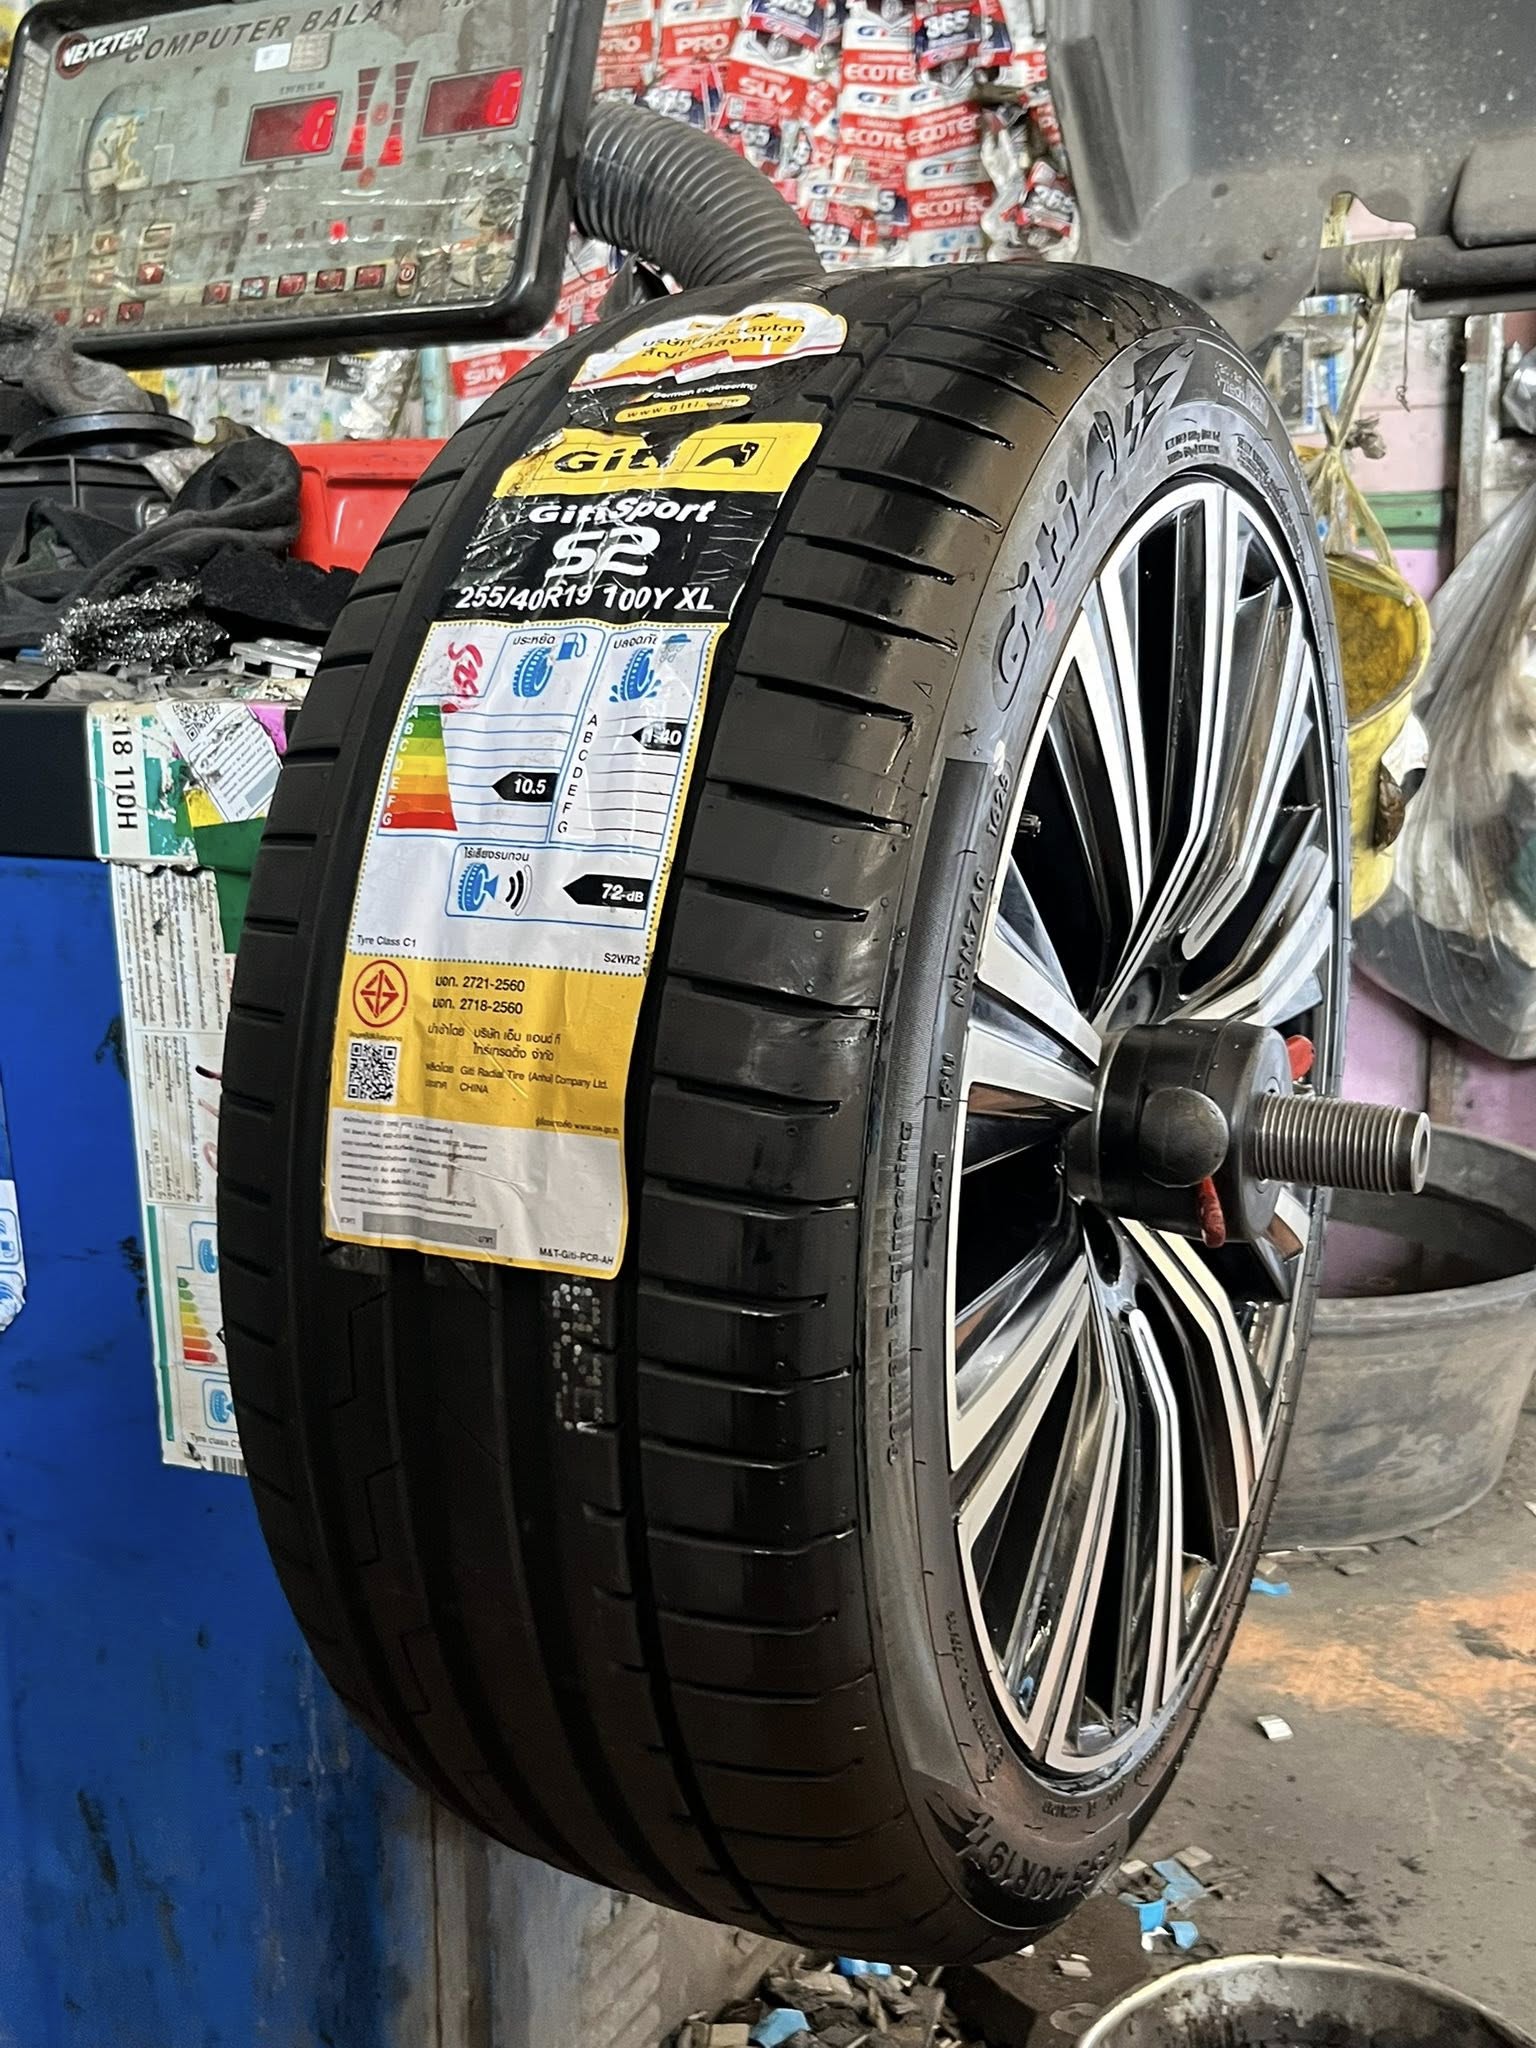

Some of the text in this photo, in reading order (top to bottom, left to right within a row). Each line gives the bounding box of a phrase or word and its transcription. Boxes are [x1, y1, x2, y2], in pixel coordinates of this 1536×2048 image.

[63, 25, 149, 67] NEXZTER
[125, 16, 292, 63] COMPUTER
[675, 33, 731, 54] PRO
[738, 76, 793, 103] SUV
[463, 365, 507, 385] SUV
[653, 382, 758, 400] German Engineering
[529, 497, 717, 524] GitiSport
[546, 526, 661, 577] S2
[455, 584, 715, 611] 255/40R19 100Y XL
[408, 706, 419, 719] A
[587, 714, 598, 726] A
[404, 722, 414, 735] B
[583, 732, 593, 743] B
[399, 740, 409, 752] C
[578, 749, 588, 761] C
[573, 766, 583, 778] D
[390, 777, 400, 789] E
[514, 779, 547, 795] 10.5
[568, 784, 578, 796] E
[114, 765, 138, 829] 110H
[386, 795, 396, 808] F
[562, 802, 572, 813] F
[382, 812, 392, 825] G
[557, 821, 568, 833] G
[601, 883, 644, 903] 72-dB
[357, 934, 416, 947] Tyre Class C1
[603, 952, 641, 965] S2WR2
[435, 975, 525, 992] มอก. 2721-2560
[432, 997, 523, 1015] มอก. 2718-2560
[507, 1069, 525, 1081] Tire
[555, 1074, 591, 1090] Company
[460, 1082, 489, 1094] CHINA
